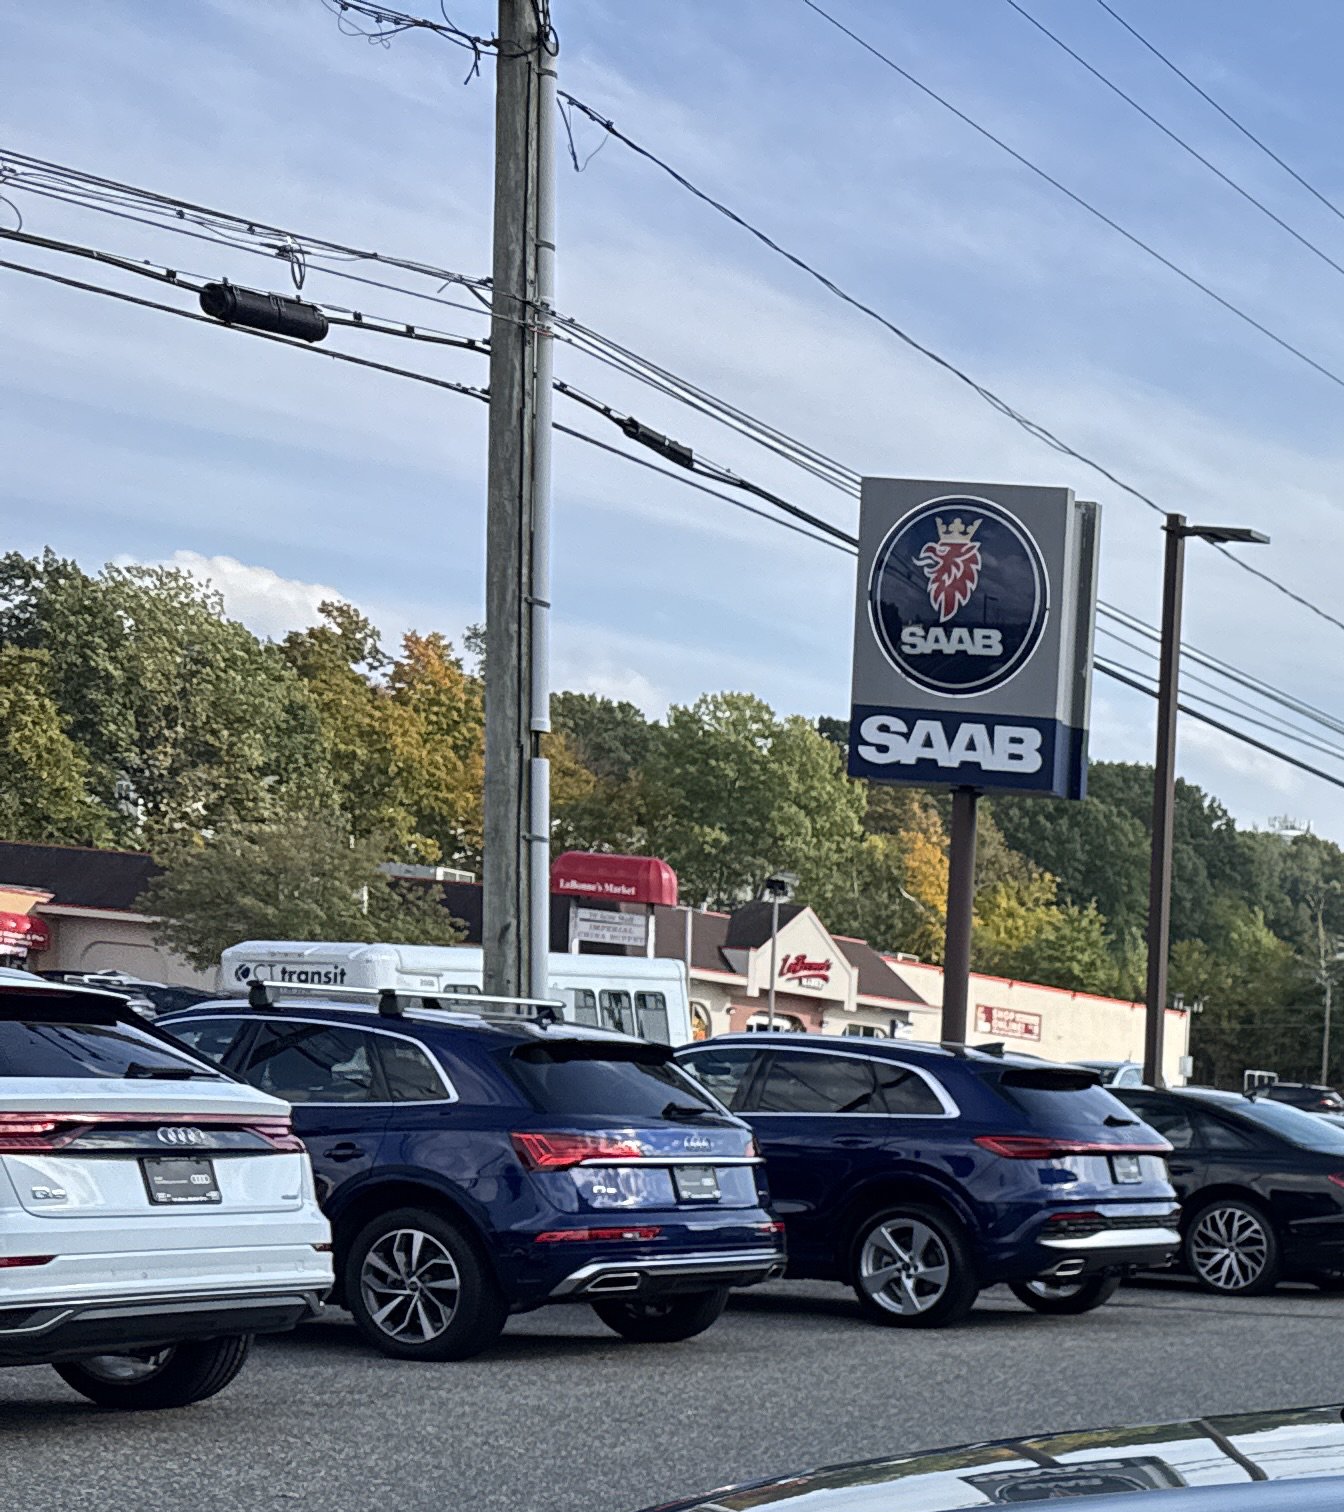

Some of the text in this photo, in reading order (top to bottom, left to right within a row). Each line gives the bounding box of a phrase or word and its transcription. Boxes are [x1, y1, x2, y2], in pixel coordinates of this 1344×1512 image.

[900, 626, 1003, 657] SAAB
[857, 714, 1043, 774] SAAB
[605, 883, 637, 896] Market
[280, 964, 347, 985] transit
